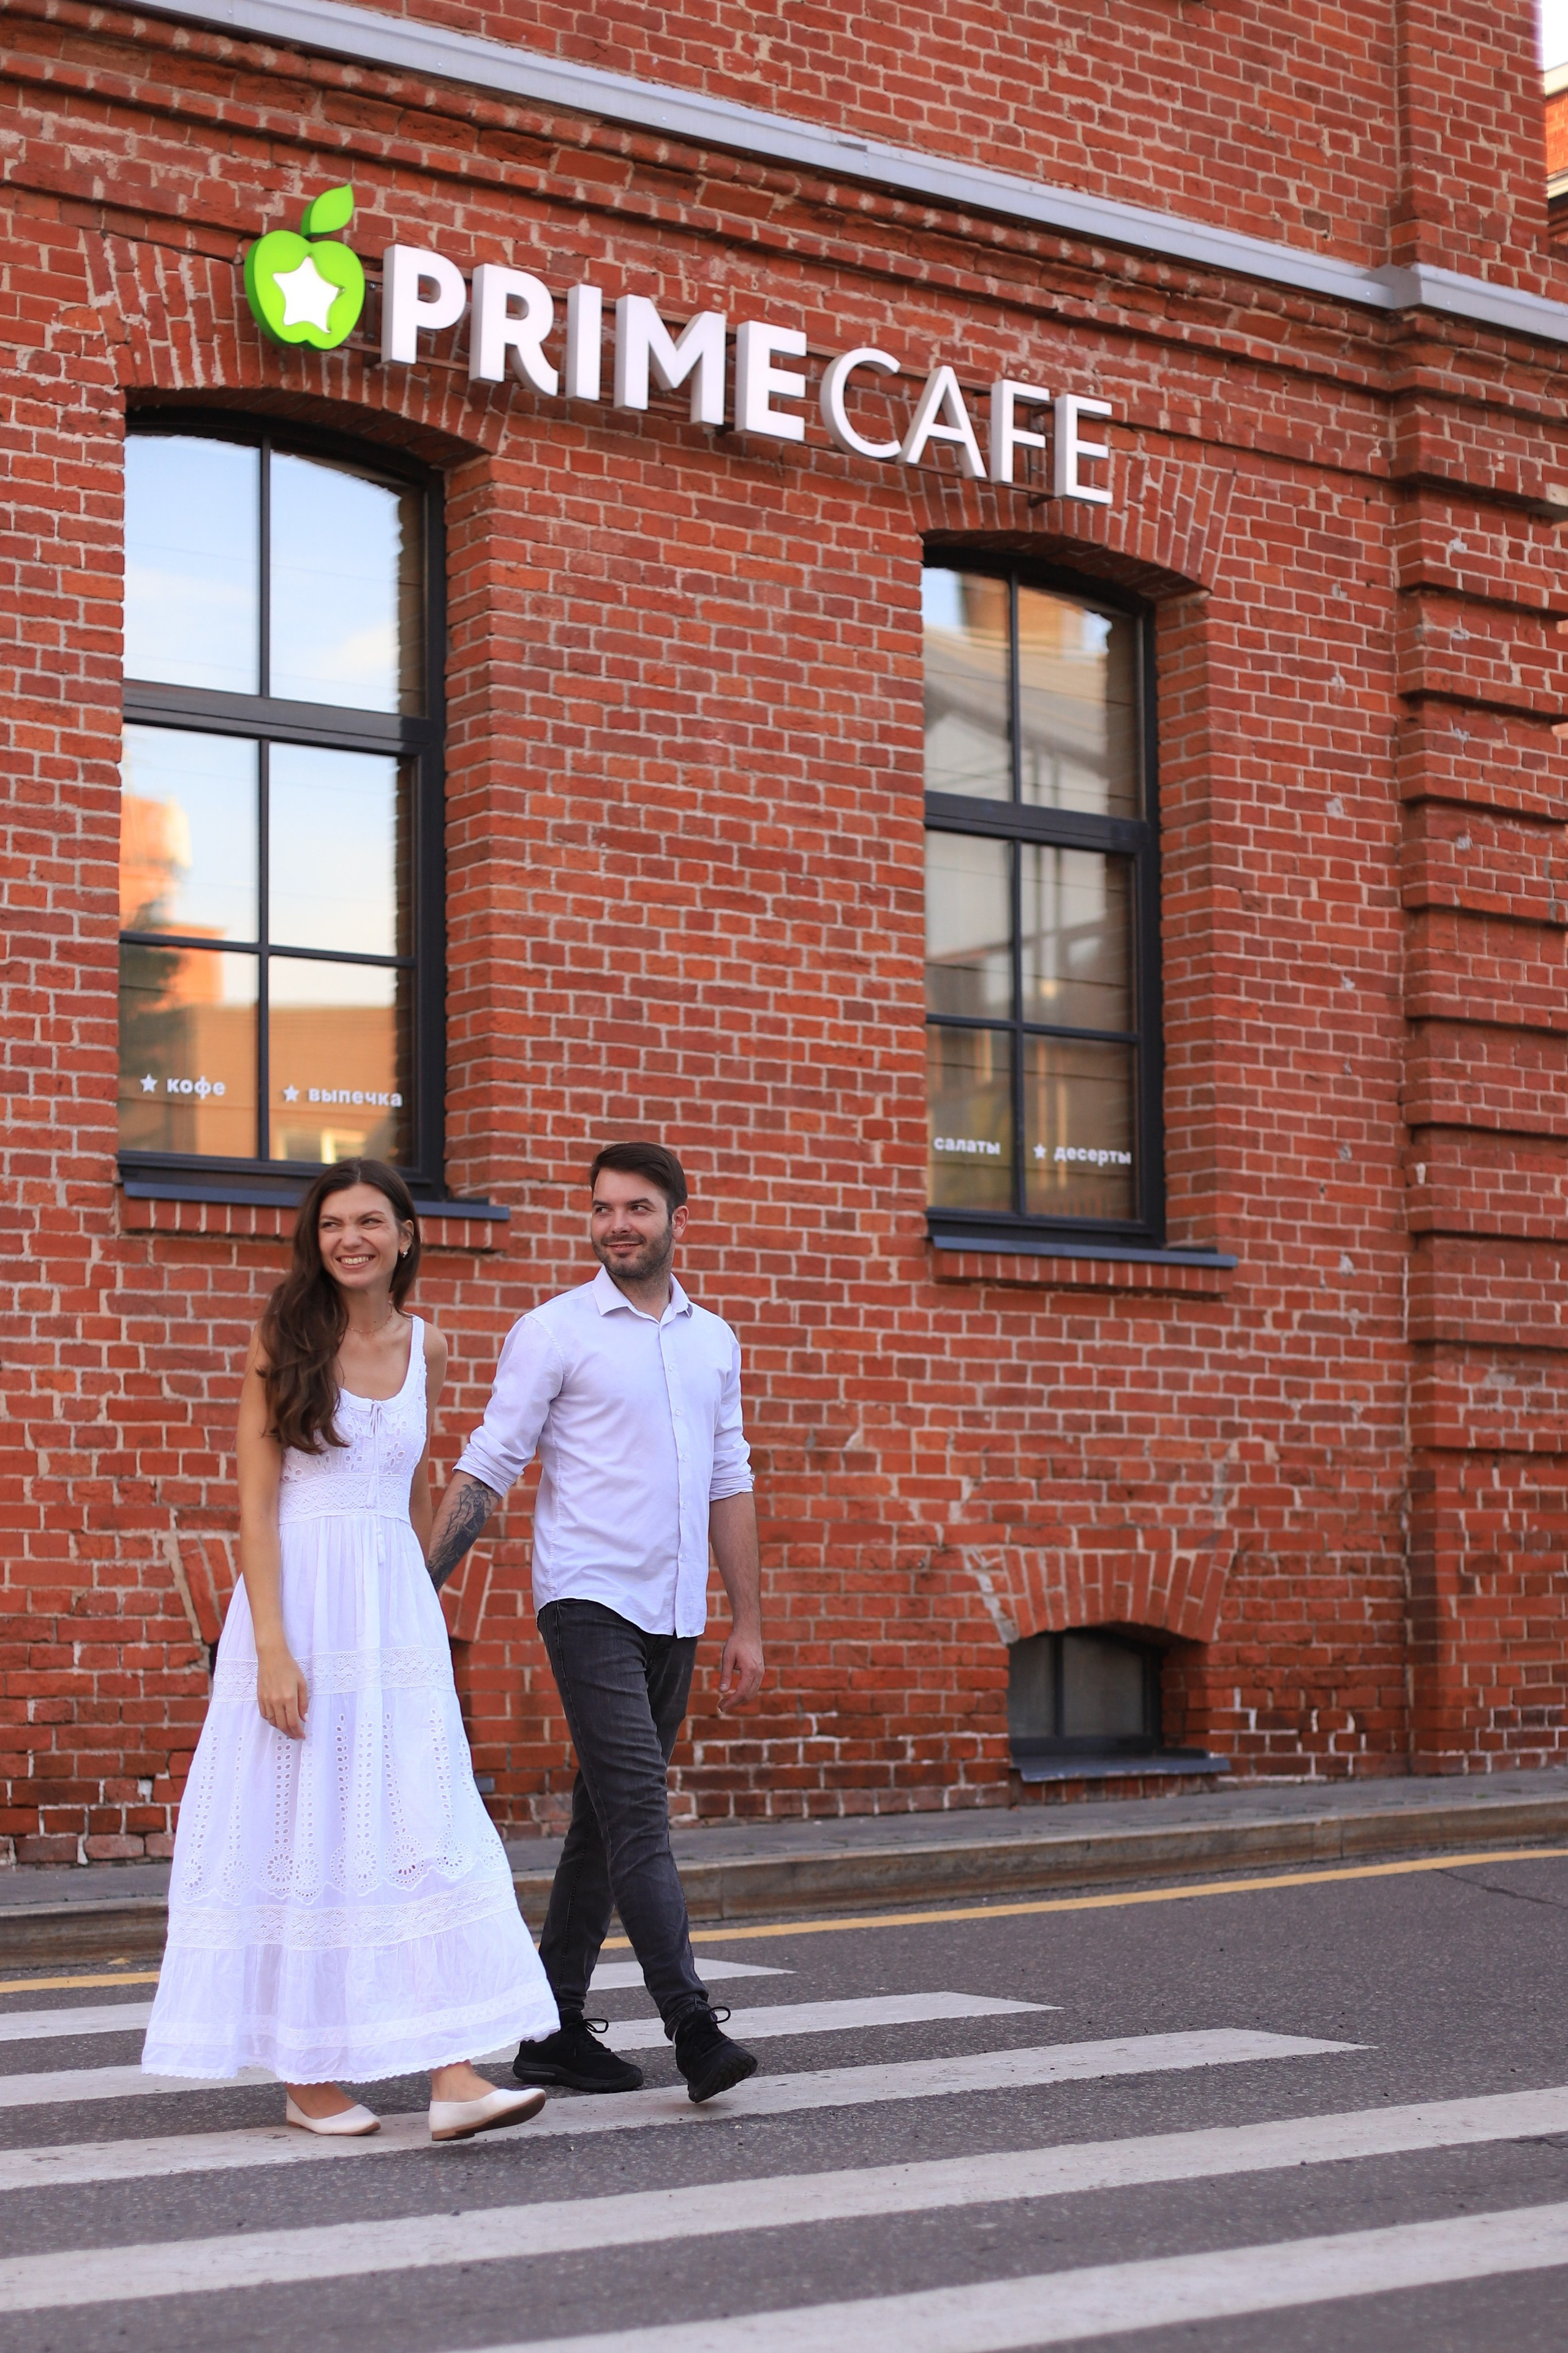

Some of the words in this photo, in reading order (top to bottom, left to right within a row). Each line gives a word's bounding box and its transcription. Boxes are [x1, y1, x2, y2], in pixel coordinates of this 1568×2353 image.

[167, 1075, 227, 1100] кофе
[308, 1087, 403, 1108] выпечка
[933, 1137, 1001, 1155] салаты
[1054, 1146, 1132, 1166] десерты
